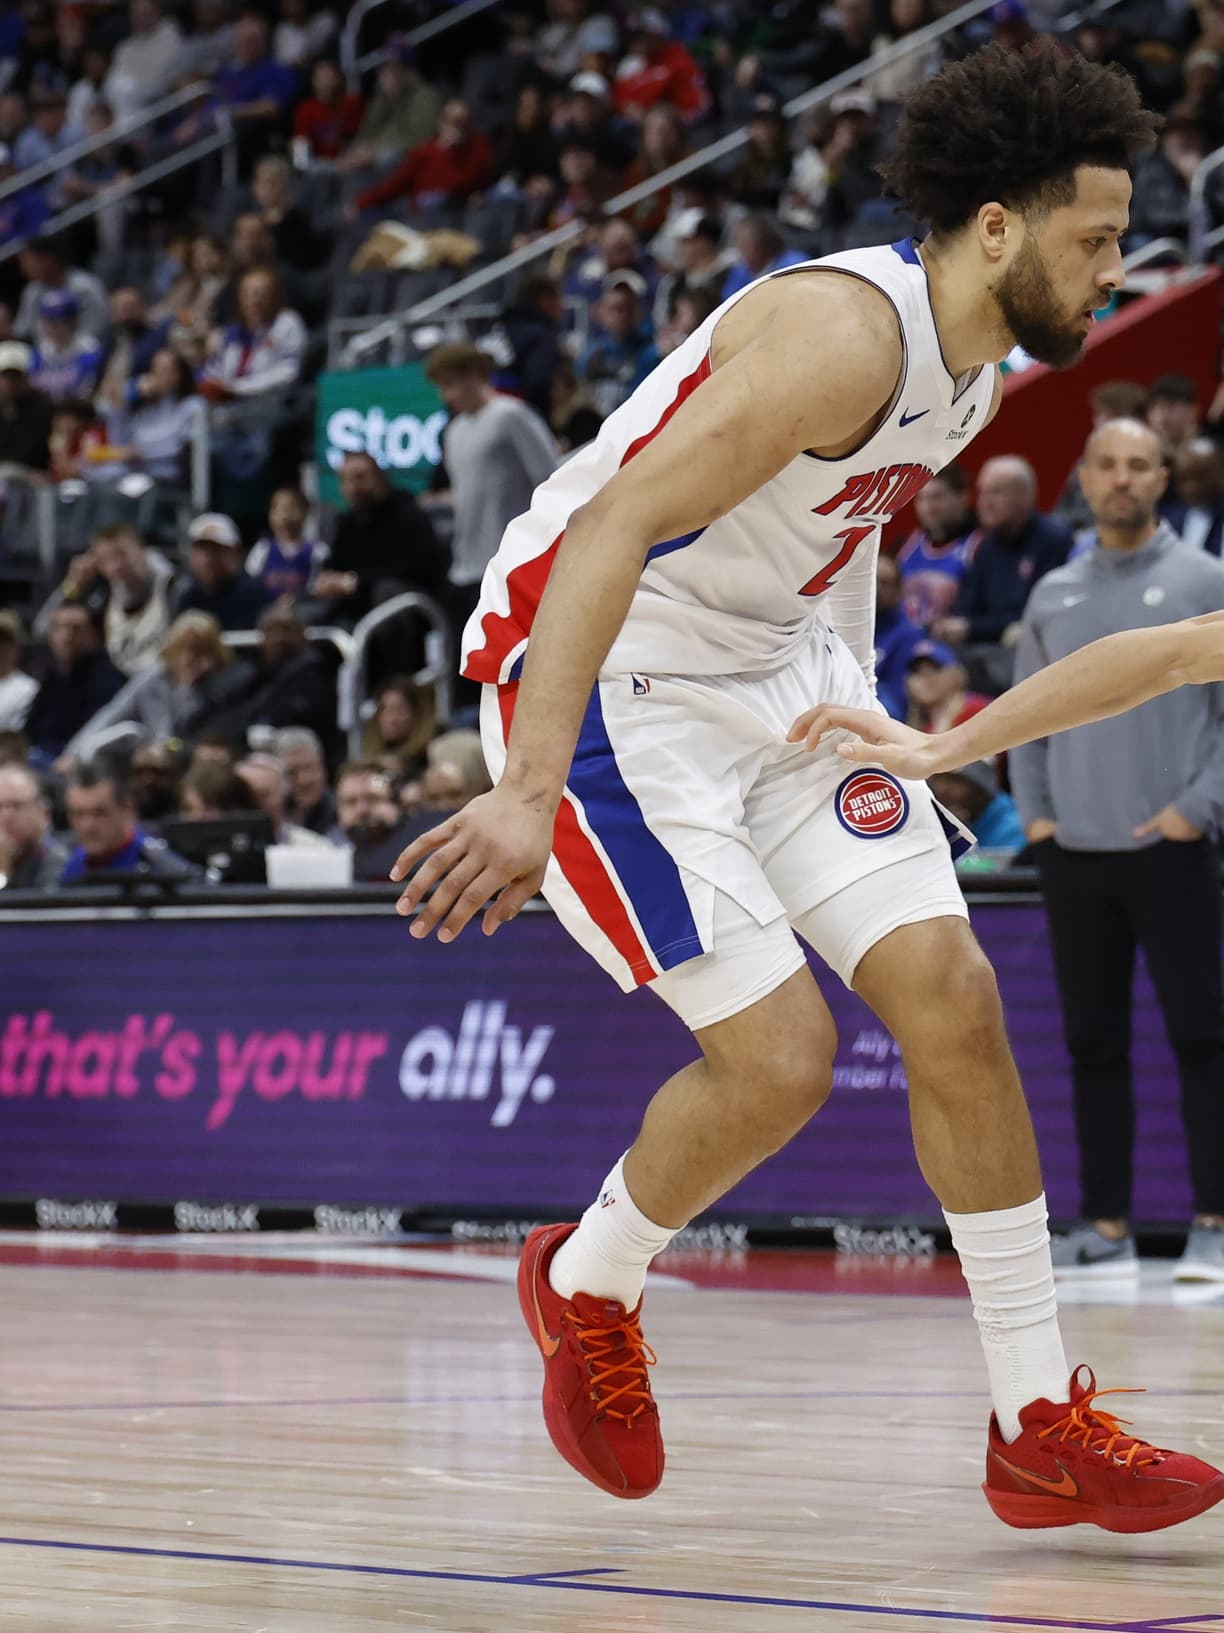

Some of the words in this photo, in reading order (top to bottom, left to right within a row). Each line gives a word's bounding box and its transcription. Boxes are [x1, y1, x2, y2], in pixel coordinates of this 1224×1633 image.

[810, 462, 934, 519] PISTO
[848, 787, 892, 810] DETROIT
[852, 797, 897, 821] PISTONS
[0, 1010, 202, 1098] that's
[206, 1028, 390, 1131] your
